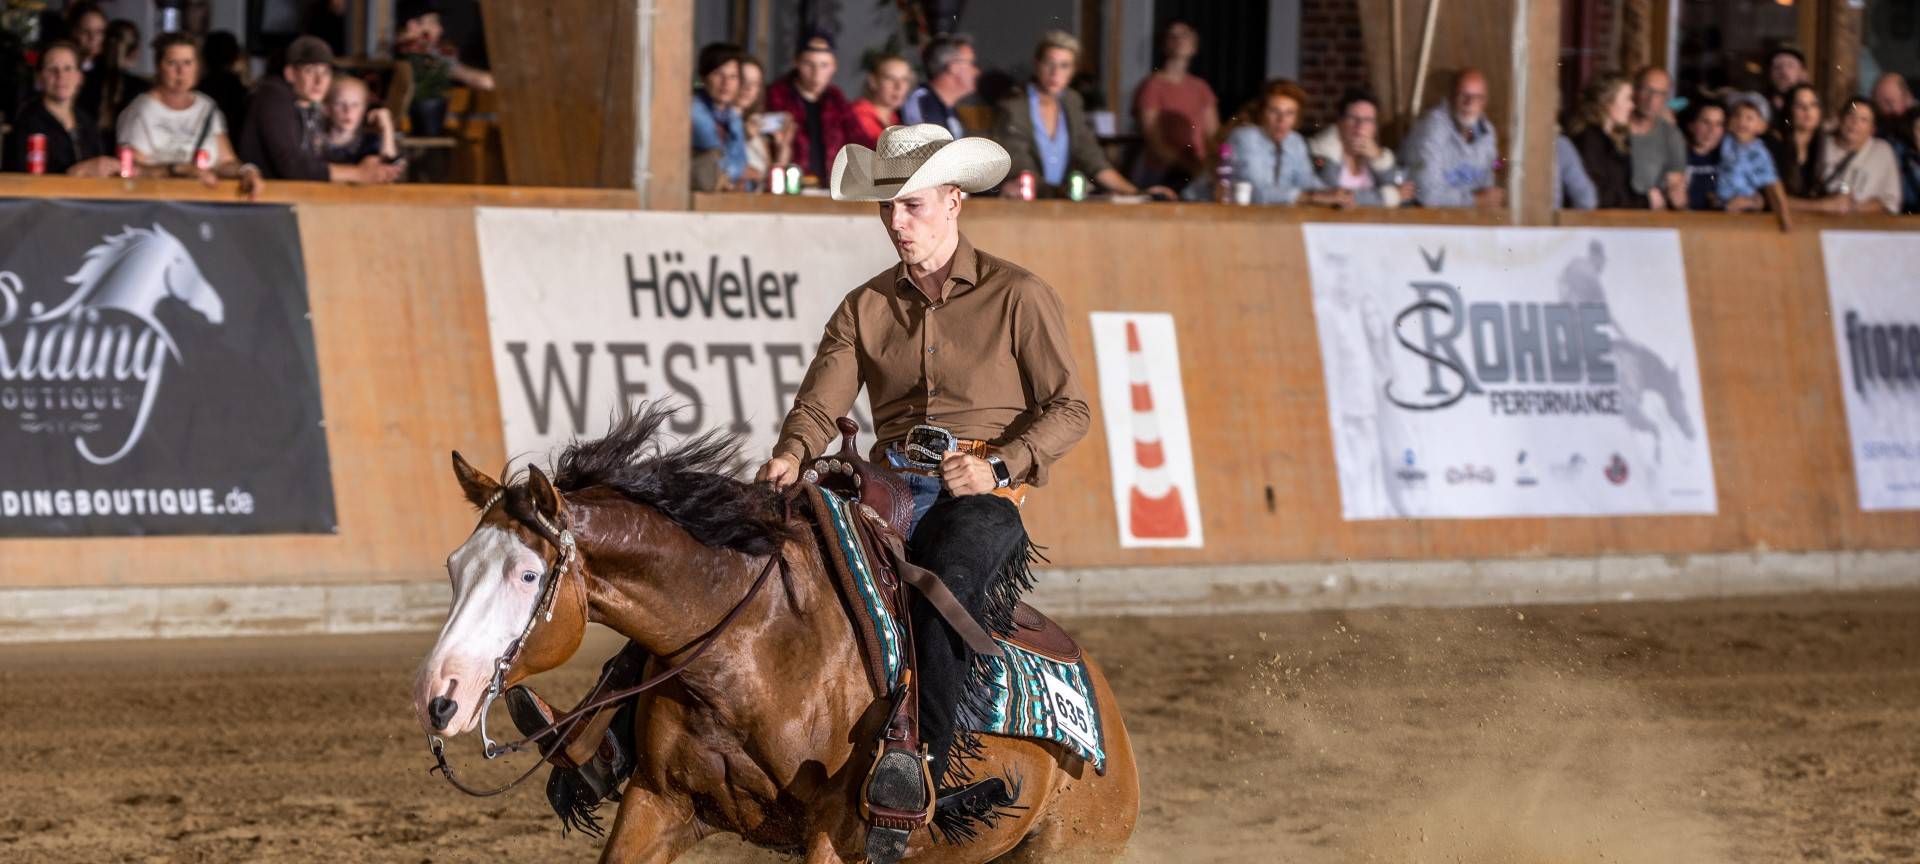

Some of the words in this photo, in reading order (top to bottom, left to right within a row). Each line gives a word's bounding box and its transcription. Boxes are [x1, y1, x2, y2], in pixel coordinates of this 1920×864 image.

[625, 251, 799, 319] Höveler
[506, 341, 873, 435] WESTE
[1489, 389, 1624, 416] PERFORMANCE
[0, 486, 254, 516] DINGBOUTIQUE.de
[1055, 692, 1088, 734] 635
